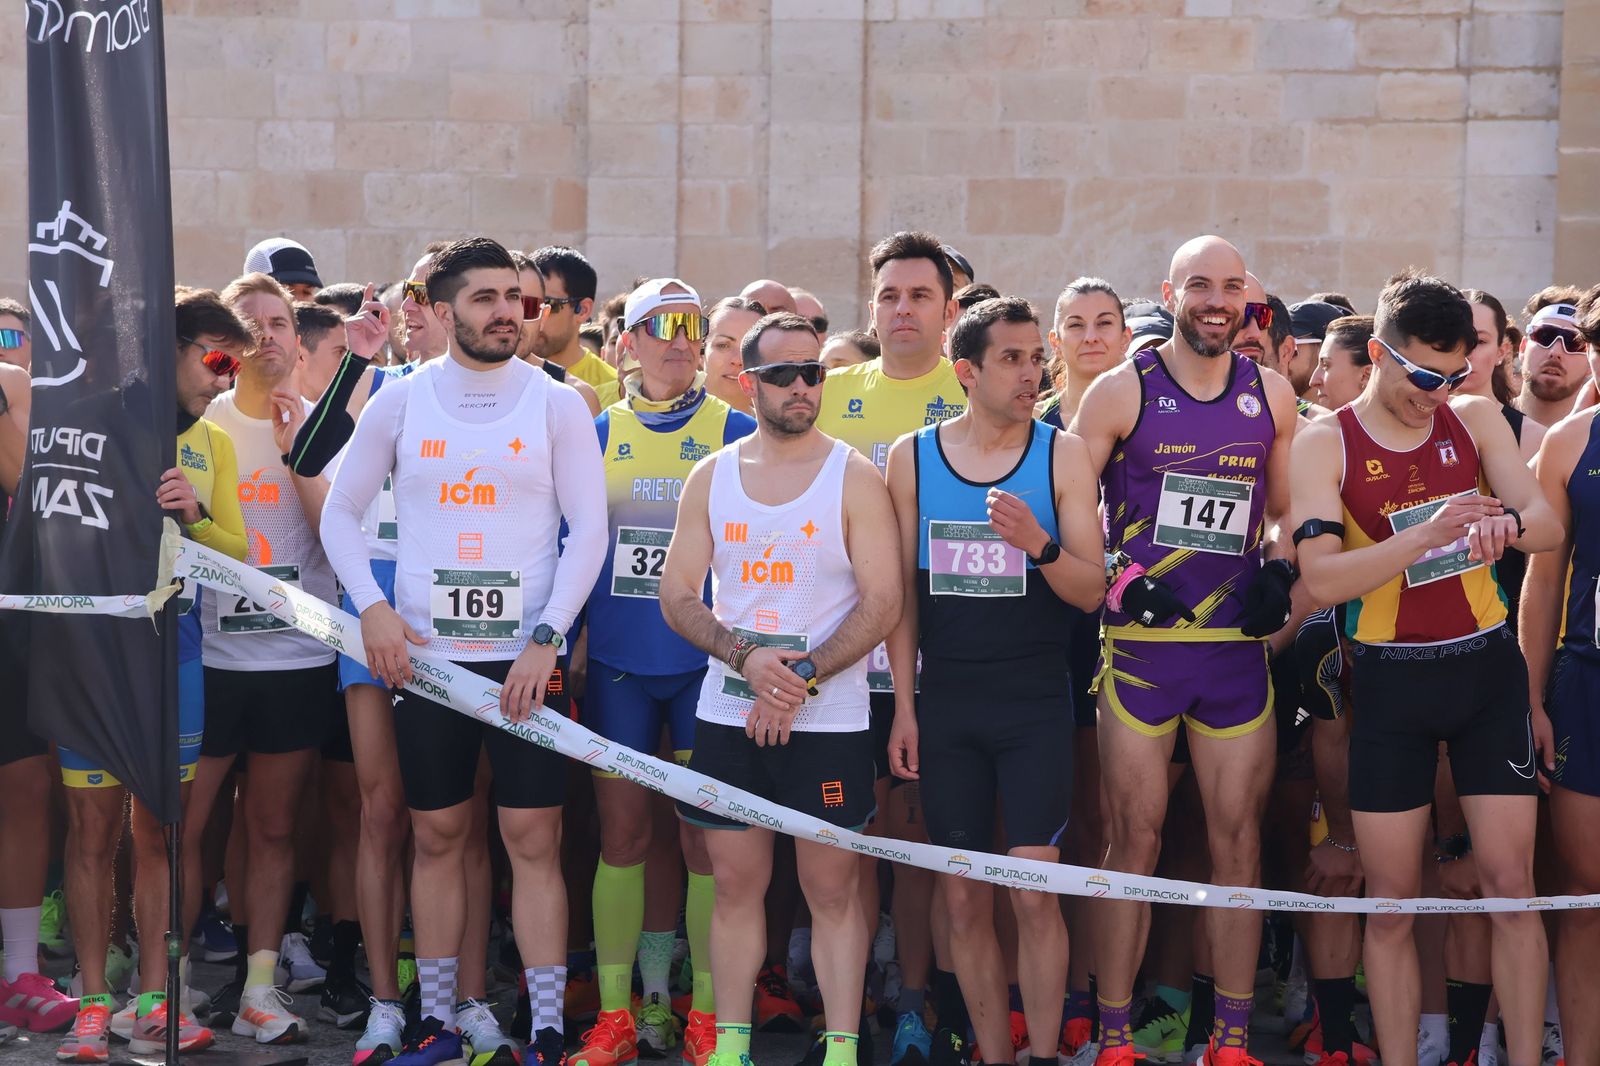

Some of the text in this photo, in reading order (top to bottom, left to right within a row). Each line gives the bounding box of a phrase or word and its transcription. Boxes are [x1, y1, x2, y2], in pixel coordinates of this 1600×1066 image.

[1154, 442, 1196, 454] Jamón
[180, 459, 208, 472] DUERO
[1218, 455, 1257, 468] PRIM
[631, 477, 684, 502] PRIETO
[1180, 496, 1237, 531] 147
[947, 542, 1007, 575] 733
[188, 564, 249, 595] ZAMO
[23, 596, 95, 610] ZAMORA
[447, 588, 504, 618] 169
[1381, 645, 1436, 661] NIKE
[1439, 636, 1487, 659] PRO
[408, 656, 454, 683] PUTACION
